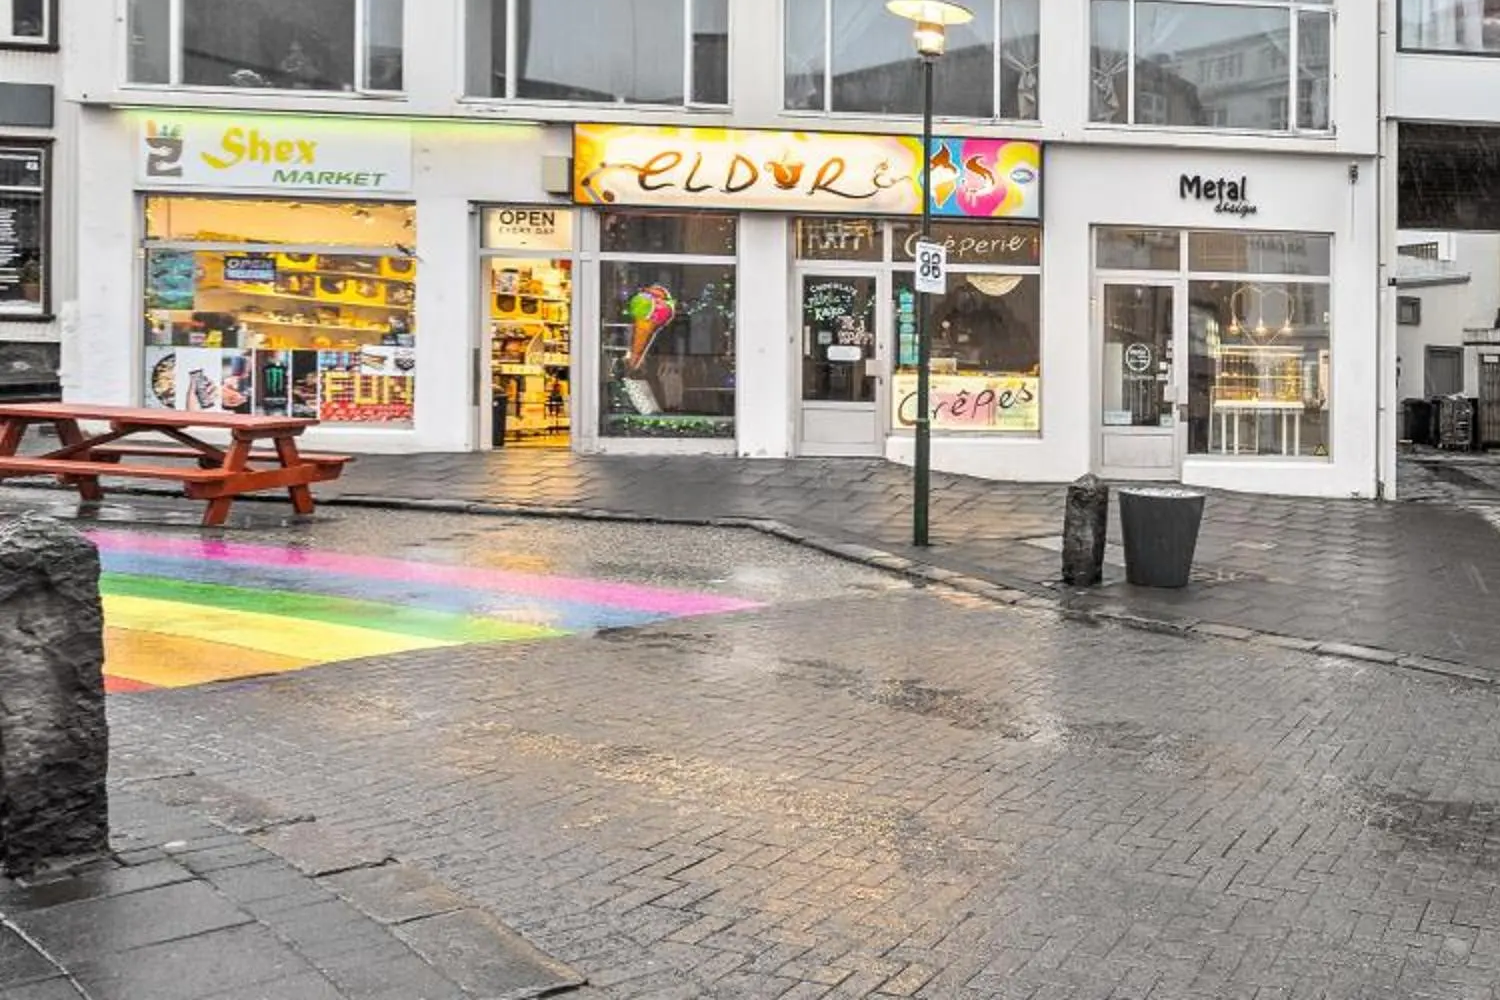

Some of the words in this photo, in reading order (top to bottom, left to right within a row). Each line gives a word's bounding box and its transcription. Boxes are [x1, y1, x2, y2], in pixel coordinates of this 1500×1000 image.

[201, 127, 318, 169] Shex
[272, 169, 386, 187] MARKET
[1180, 174, 1247, 203] Metal
[499, 209, 555, 227] OPEN
